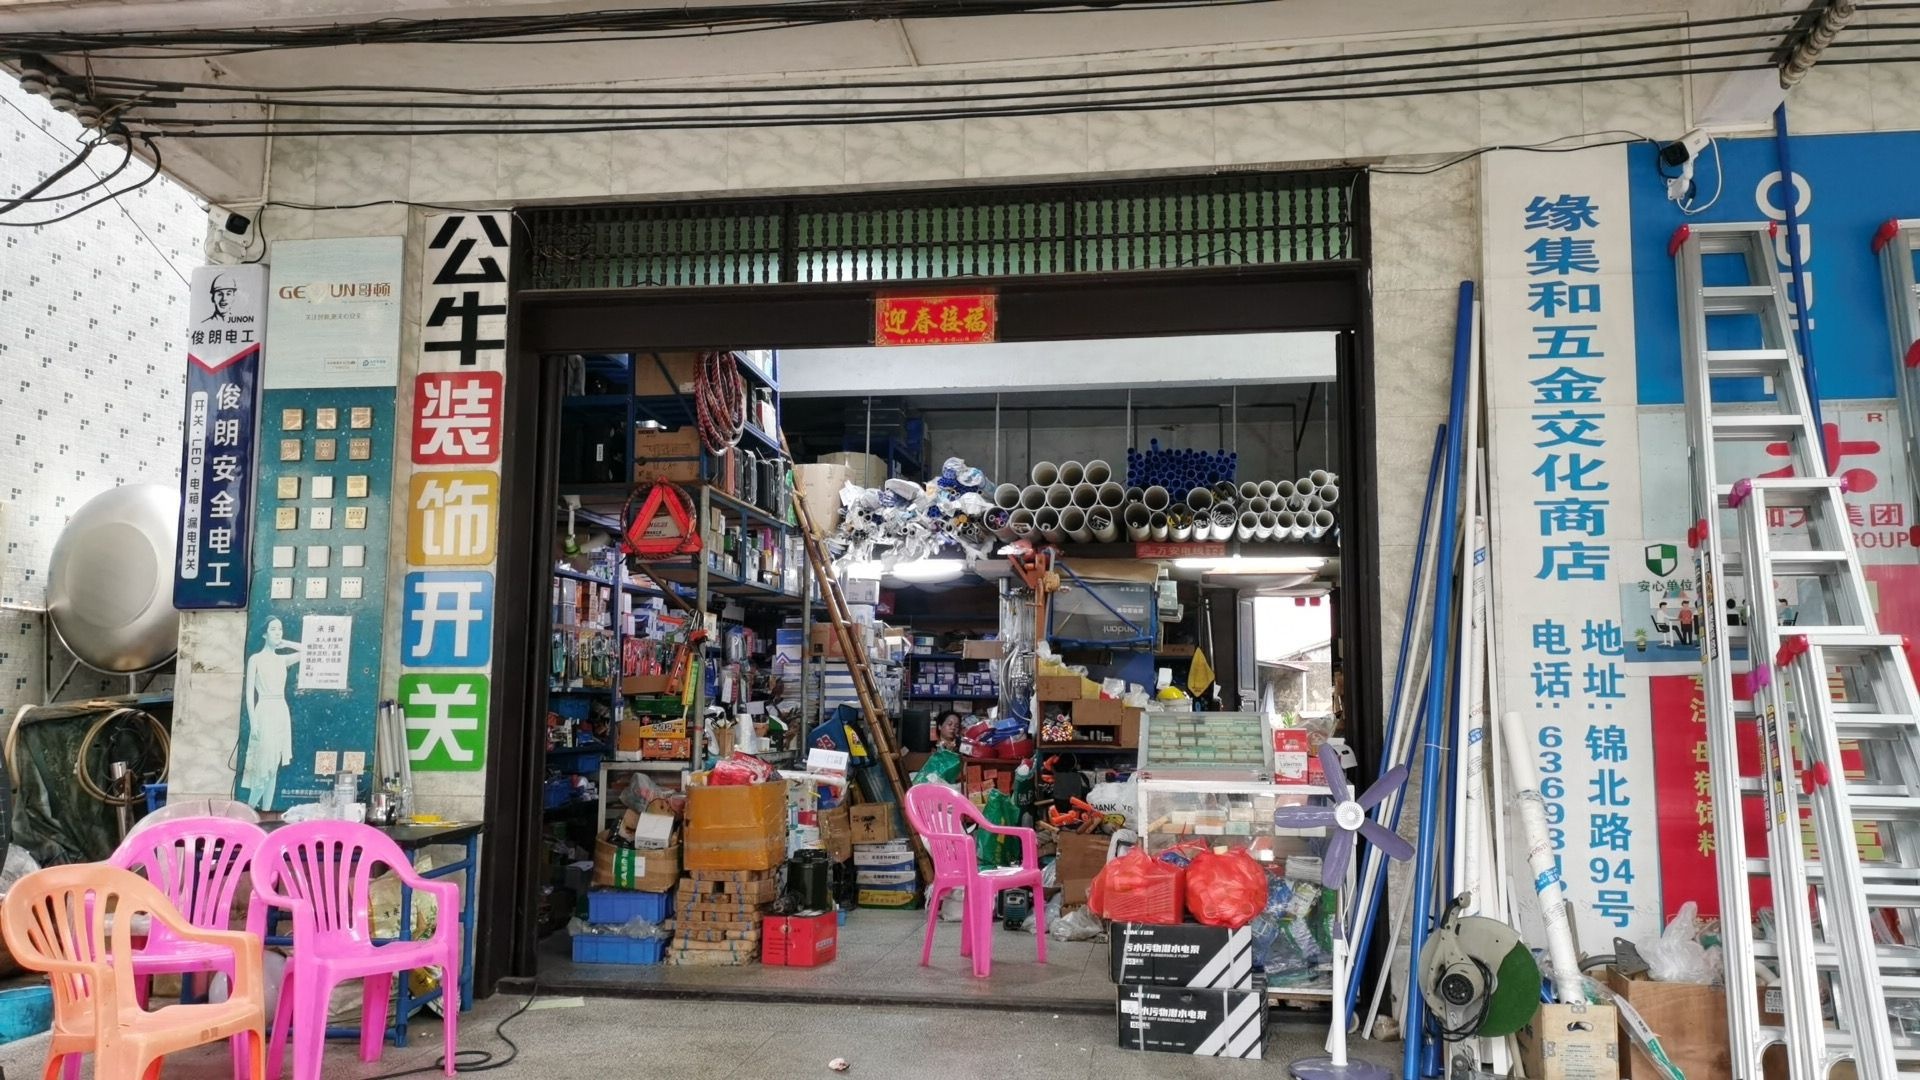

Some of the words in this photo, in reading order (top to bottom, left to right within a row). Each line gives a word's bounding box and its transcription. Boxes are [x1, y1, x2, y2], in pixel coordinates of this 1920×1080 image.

[279, 283, 355, 299] GEUN
[227, 314, 254, 323] JUNON
[884, 305, 988, 335] 迎春接福
[191, 329, 255, 345] 俊朗电工
[1524, 193, 1610, 581] 缘集和五金交化商店
[206, 383, 241, 586] 俊朗安全电工
[1638, 579, 1694, 593] 安心单位
[1091, 803, 1117, 812] HANK
[1131, 1006, 1207, 1020] 水污物潜水电泵
